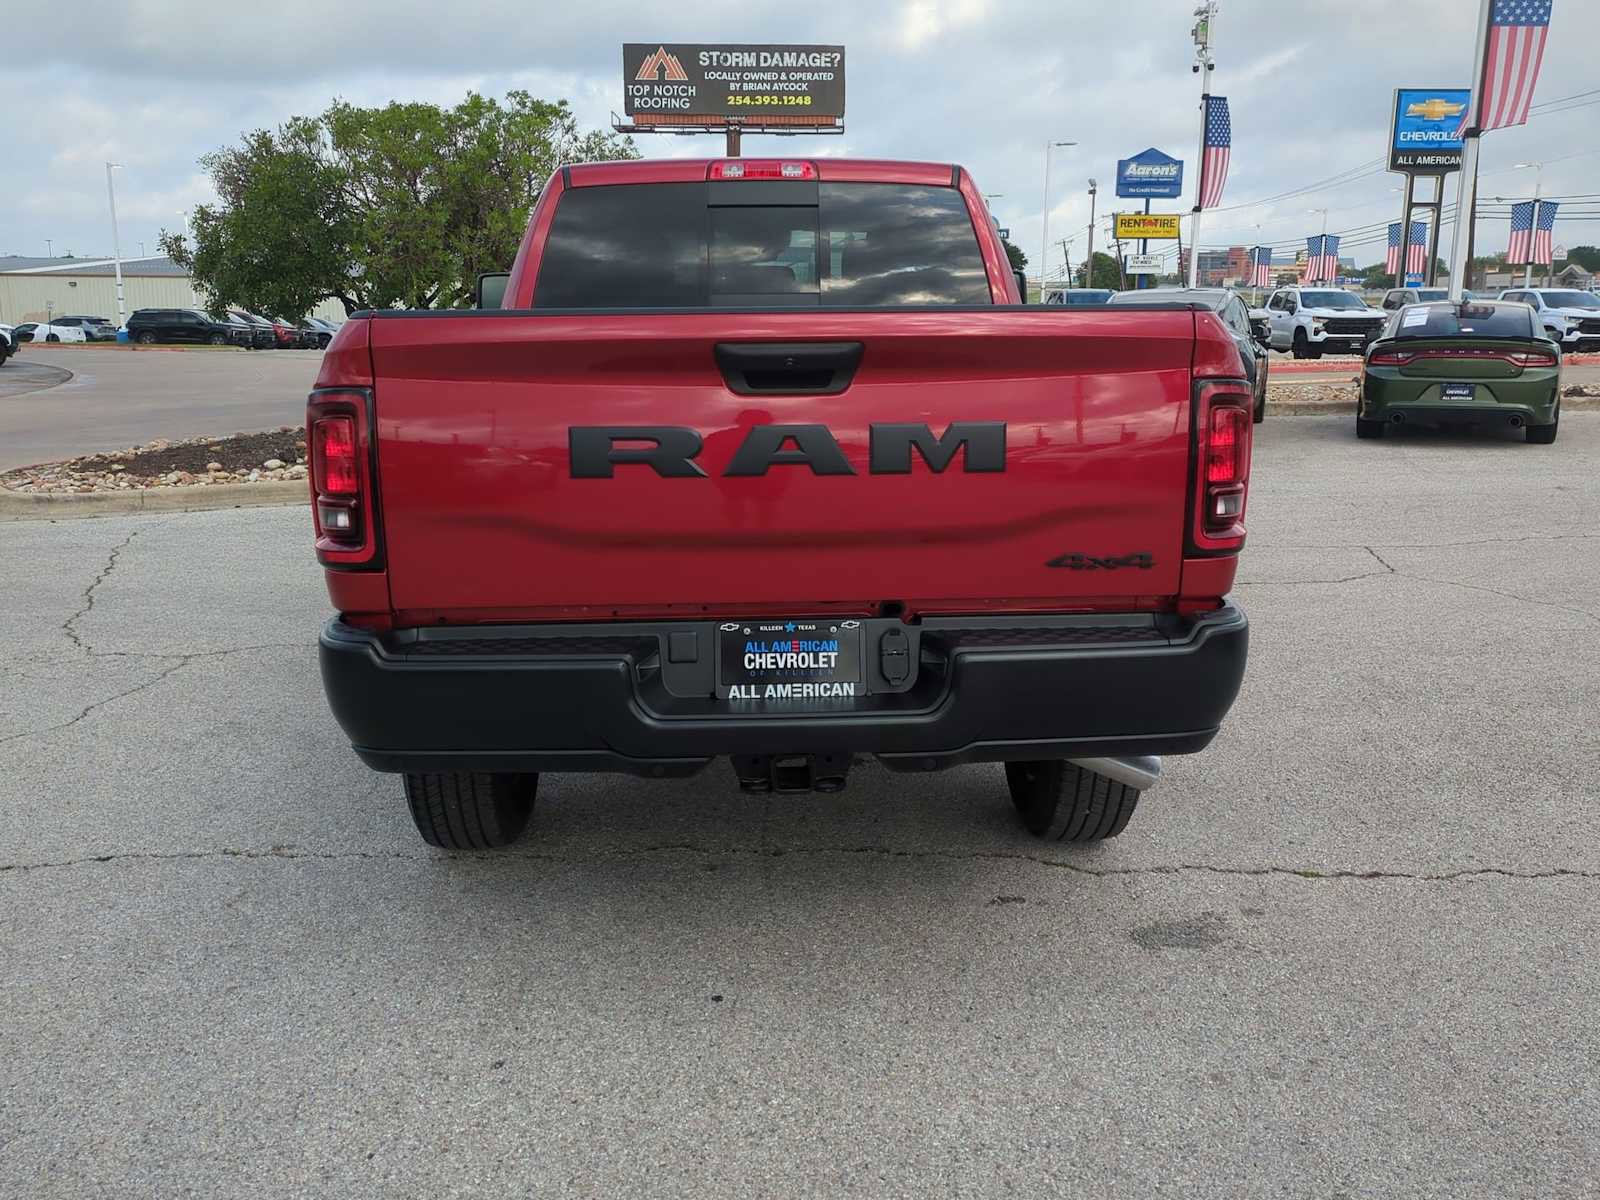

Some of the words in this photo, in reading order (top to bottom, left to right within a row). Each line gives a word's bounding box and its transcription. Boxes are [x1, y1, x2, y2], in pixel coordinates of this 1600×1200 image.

[699, 51, 756, 67] STORM
[760, 52, 841, 68] DAMAGE?
[704, 71, 742, 81] LOCALLY
[743, 72, 779, 81] OWNED
[780, 72, 788, 81] &
[789, 72, 834, 81] OPERATED
[627, 84, 650, 97] TOP
[653, 85, 697, 97] NOTCH
[729, 82, 741, 91] BY
[742, 82, 771, 91] BRIAN
[772, 82, 809, 91] AYCOCK
[633, 97, 691, 110] ROOFING
[727, 95, 812, 106] 254.393.1248
[1400, 131, 1463, 141] CHEVROLE
[1397, 155, 1414, 165] ALL
[1125, 163, 1178, 176] Aaron's
[1120, 218, 1146, 228] RENT
[1152, 218, 1176, 228] TIRE
[568, 421, 1008, 479] RAM
[745, 641, 769, 653] ALL
[772, 640, 838, 652] AMERICAN
[744, 652, 838, 669] CHEVROLET
[728, 685, 760, 699] ALL
[765, 682, 855, 698] AMERICAN
